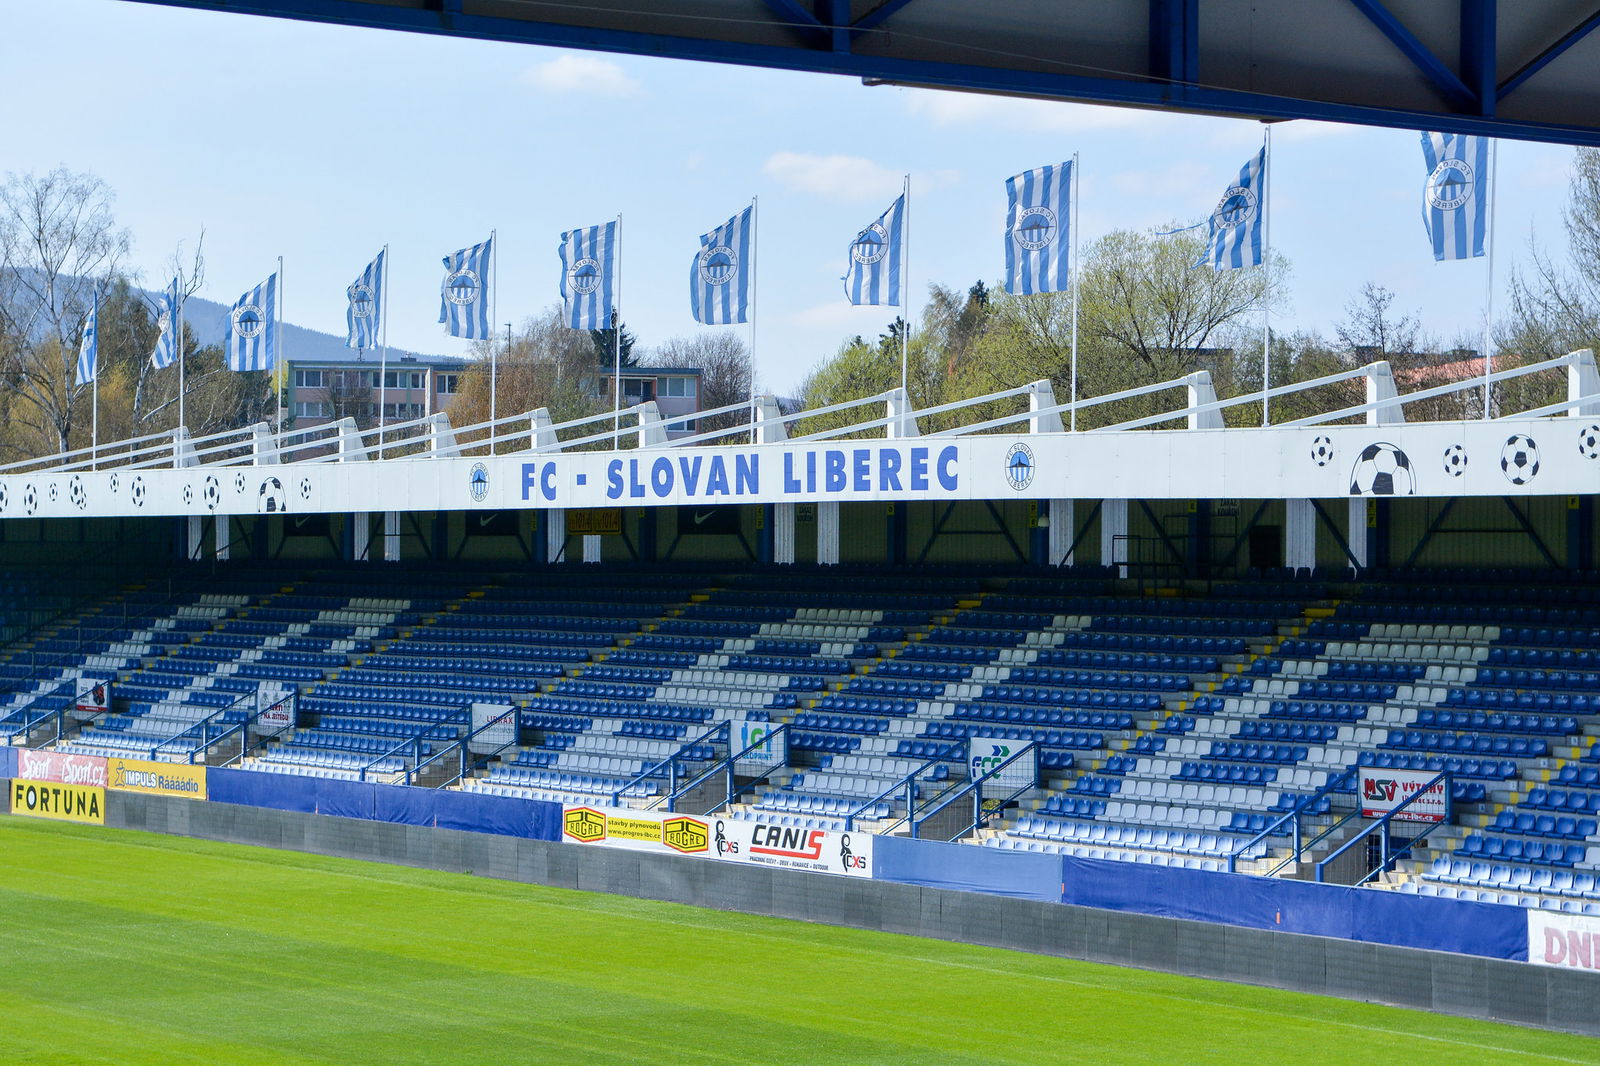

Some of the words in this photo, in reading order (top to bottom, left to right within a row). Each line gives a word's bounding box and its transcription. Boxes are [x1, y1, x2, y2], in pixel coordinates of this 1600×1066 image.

[521, 461, 557, 501] FC
[606, 453, 760, 500] SLOVAN
[783, 445, 959, 494] LIBEREC
[972, 756, 1002, 779] FCC
[125, 769, 157, 788] IMPULS
[158, 775, 199, 793] Ráááádio
[1363, 778, 1399, 802] MSV
[15, 784, 100, 818] FORTUNA
[607, 820, 628, 828] stavby
[629, 822, 661, 830] plynovodů
[720, 840, 739, 854] CXS
[751, 824, 825, 855] CANIS
[846, 853, 866, 869] CXS
